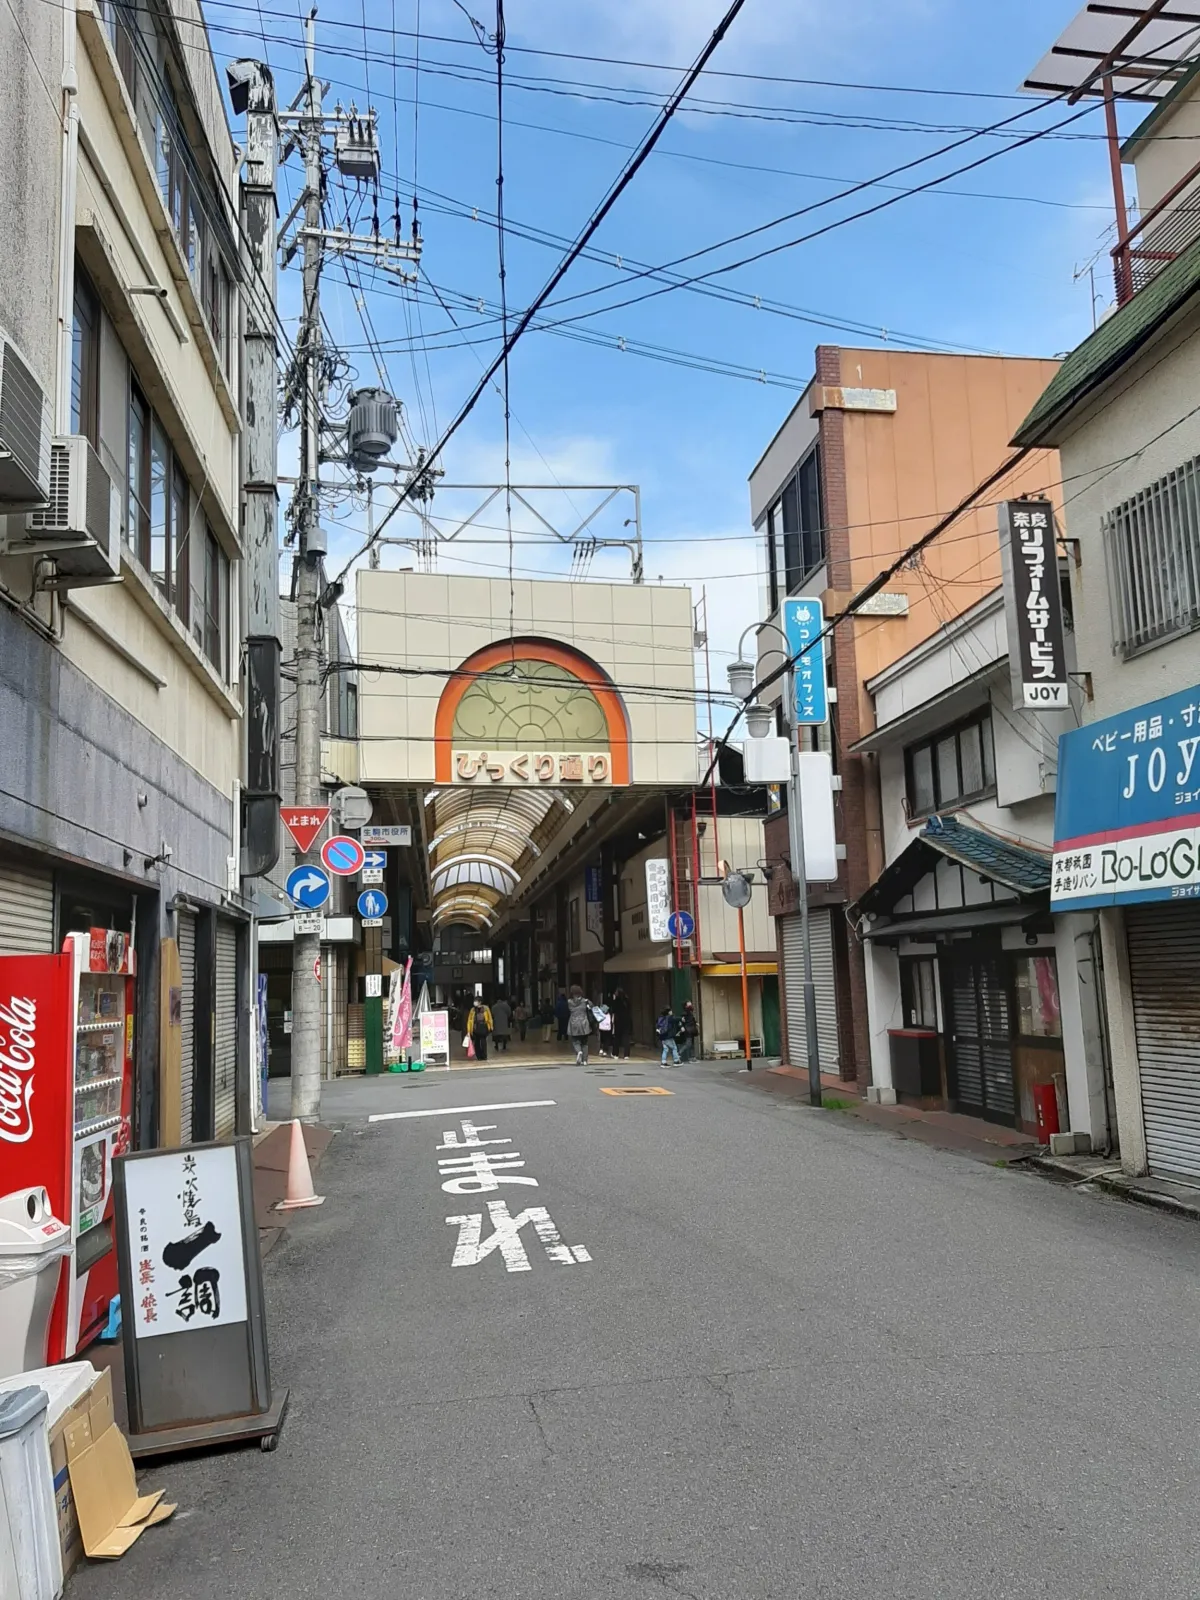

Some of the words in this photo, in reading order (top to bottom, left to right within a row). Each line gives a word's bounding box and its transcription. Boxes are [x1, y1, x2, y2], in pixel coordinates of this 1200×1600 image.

[1013, 512, 1048, 528] 奈良
[1019, 528, 1056, 679] リフォームサービス
[1029, 687, 1060, 701] JOY
[1092, 703, 1200, 752] ベビー用品・寸
[288, 815, 321, 827] 止まれ
[363, 827, 409, 838] 生駒市役所
[436, 1119, 593, 1273] 止まれ
[162, 1221, 222, 1322] 一調
